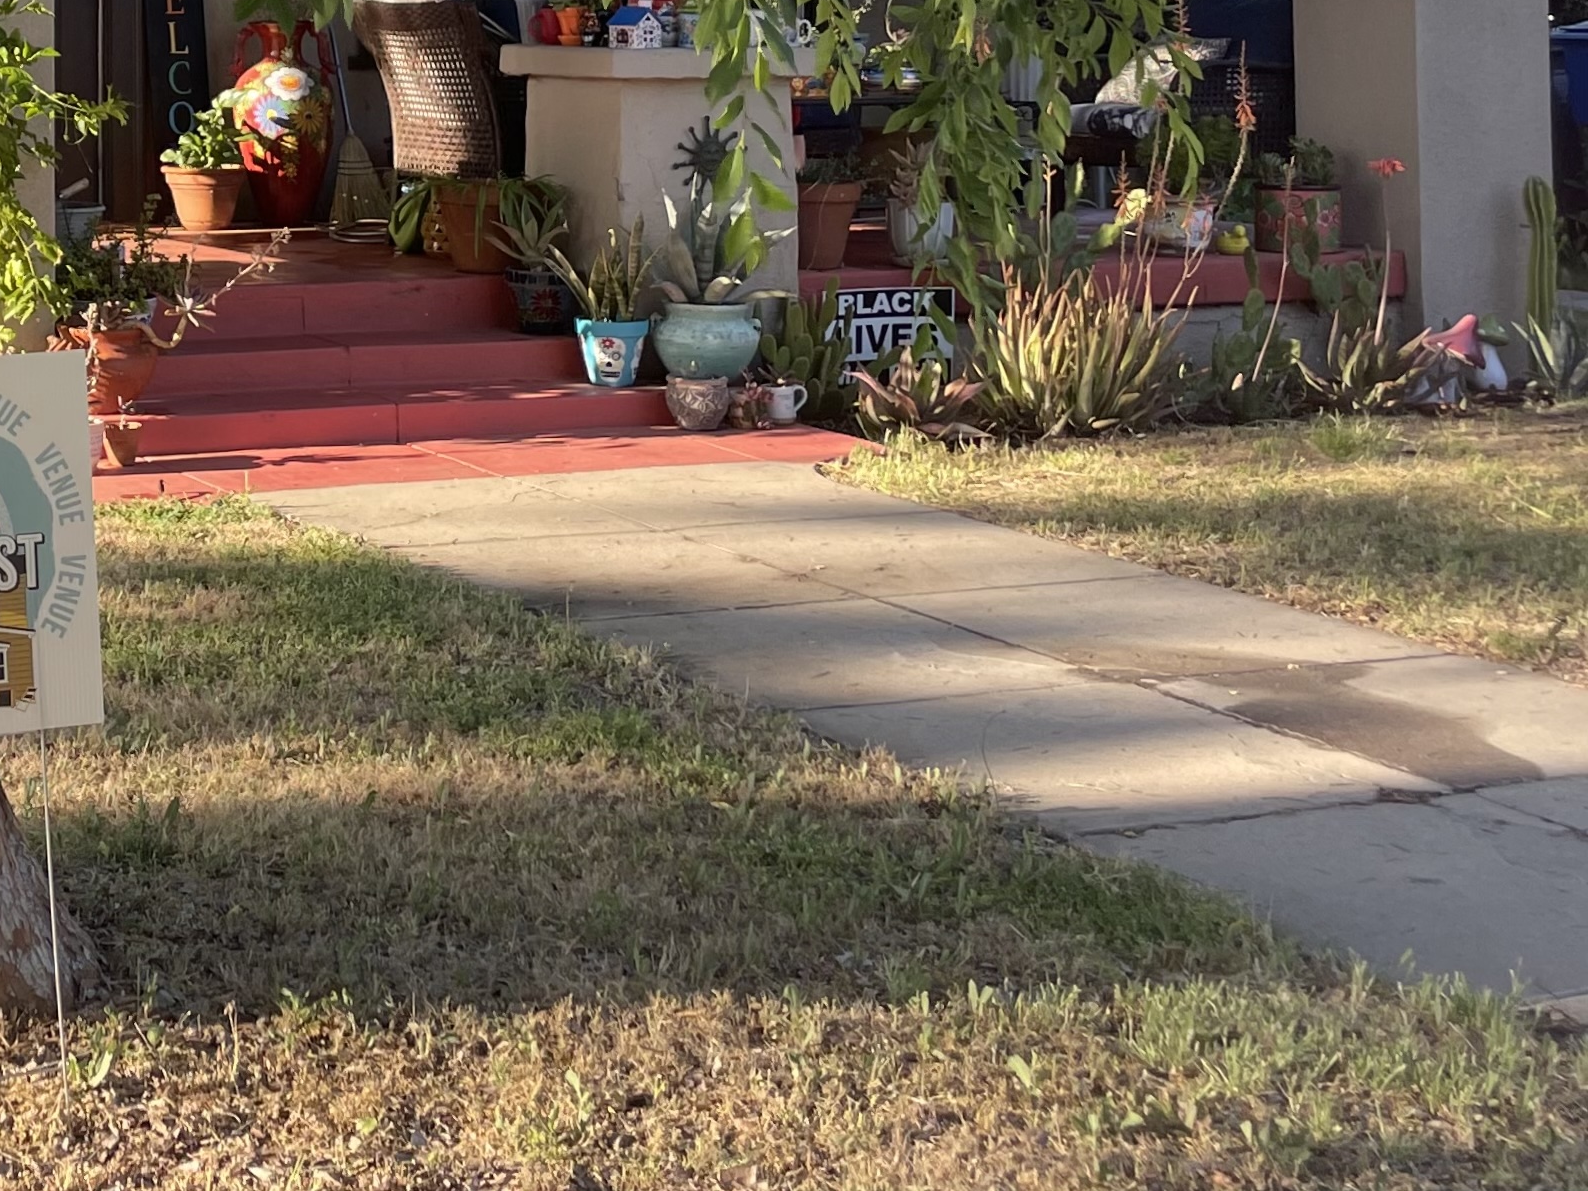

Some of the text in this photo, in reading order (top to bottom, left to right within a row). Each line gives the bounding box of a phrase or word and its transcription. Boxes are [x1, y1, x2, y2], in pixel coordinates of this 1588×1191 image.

[838, 291, 935, 316] BLACK
[835, 322, 939, 355] IVE
[34, 442, 85, 527] VENUE
[40, 553, 87, 639] VENUE
